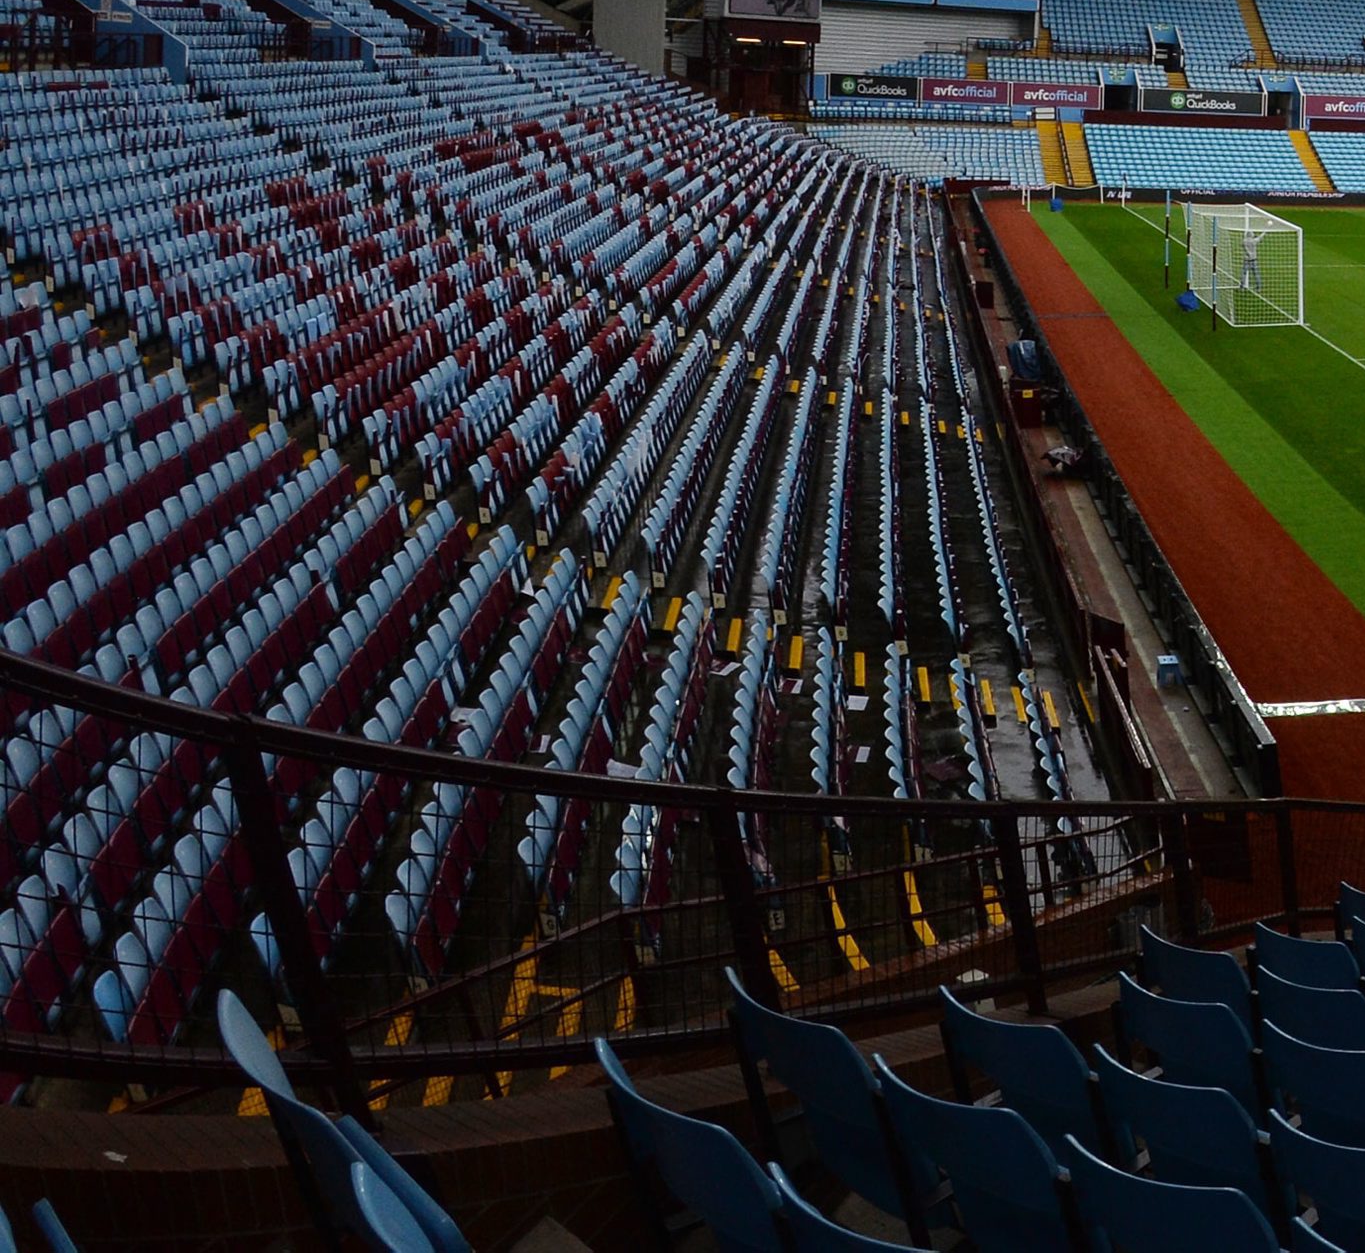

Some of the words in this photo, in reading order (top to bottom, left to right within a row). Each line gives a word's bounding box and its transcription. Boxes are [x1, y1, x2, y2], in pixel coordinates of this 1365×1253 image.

[857, 84, 908, 97] QuickBooks
[933, 85, 997, 99] avfcofficial
[1024, 88, 1088, 103] avfcofficial
[1186, 99, 1237, 111] QuickBooks
